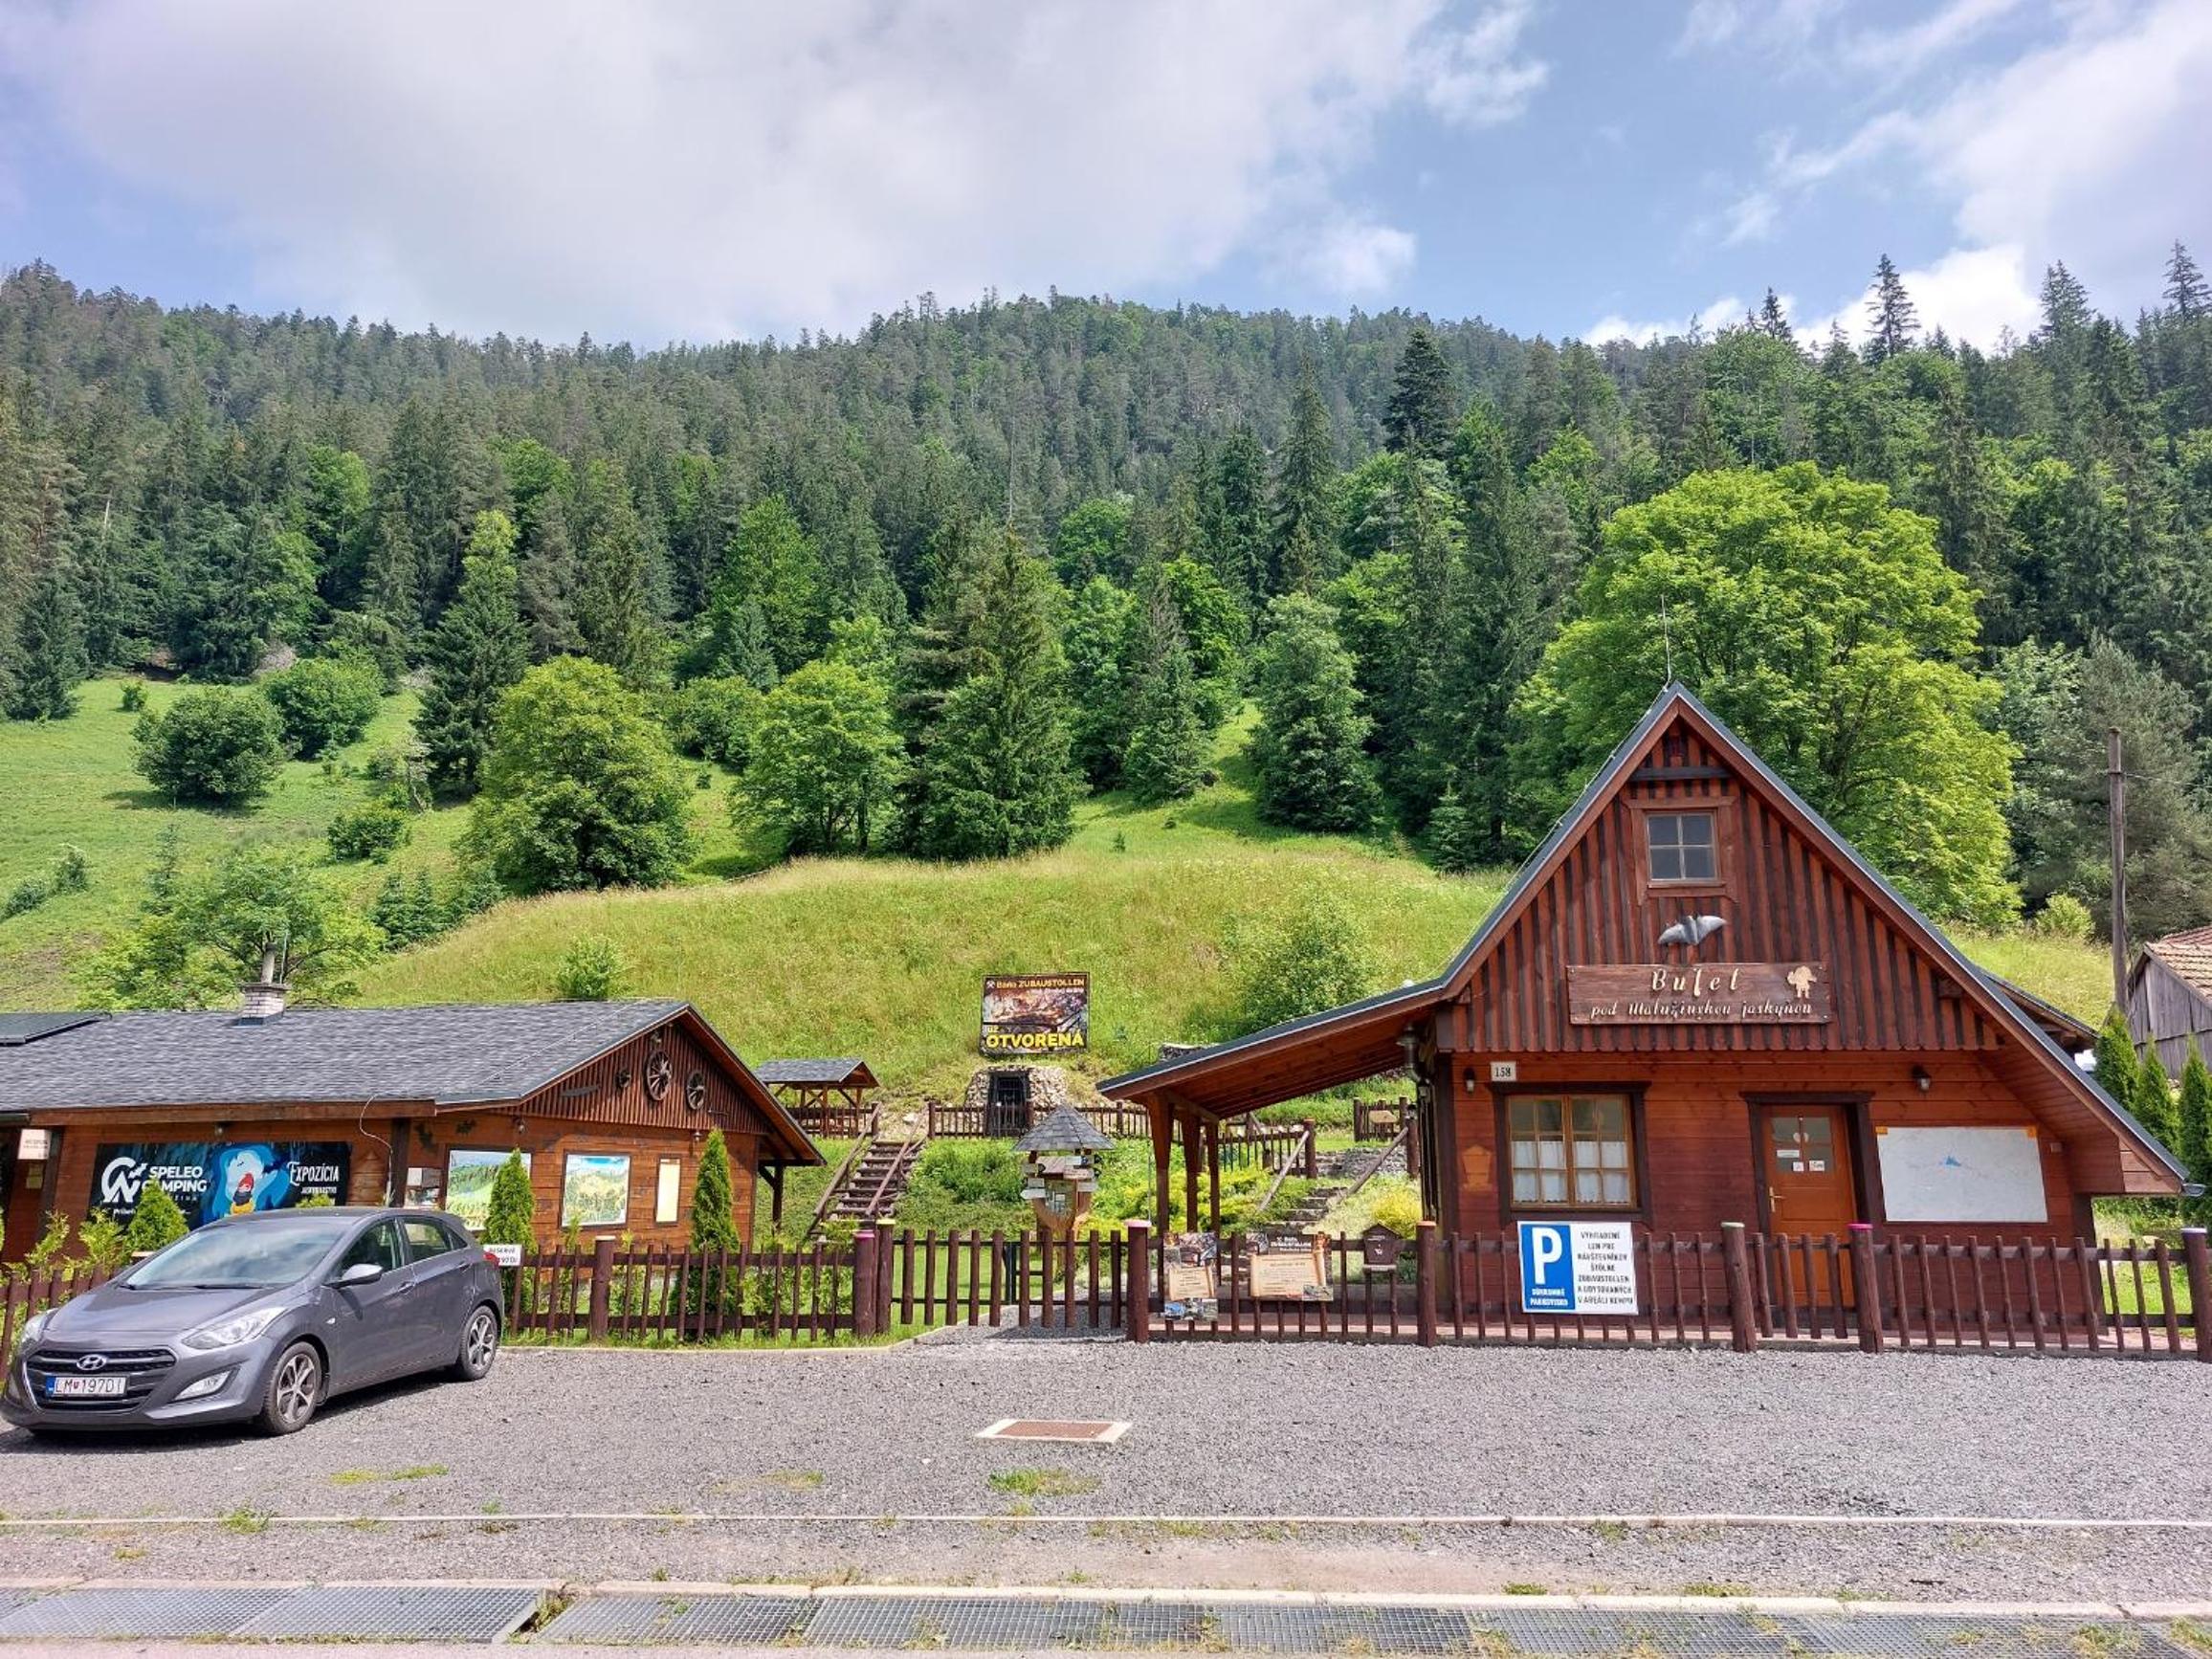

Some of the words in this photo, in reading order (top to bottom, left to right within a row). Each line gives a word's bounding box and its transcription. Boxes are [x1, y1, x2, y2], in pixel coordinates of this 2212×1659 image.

[1018, 978, 1085, 987] ZUBAUSTOLLEN
[1651, 967, 1741, 998] Bufet
[1591, 1002, 1618, 1019] pod
[1628, 1000, 1732, 1020] Malužinskou
[1741, 1001, 1812, 1020] jaskyňou
[985, 1028, 1085, 1049] OTVORENÁ
[1495, 1066, 1511, 1077] 158
[148, 1165, 204, 1179] SPELEO
[142, 1179, 208, 1193] CMPING
[1532, 1228, 1562, 1285] P
[1530, 1297, 1569, 1306] PARKOVISKO
[55, 1378, 74, 1393] LM
